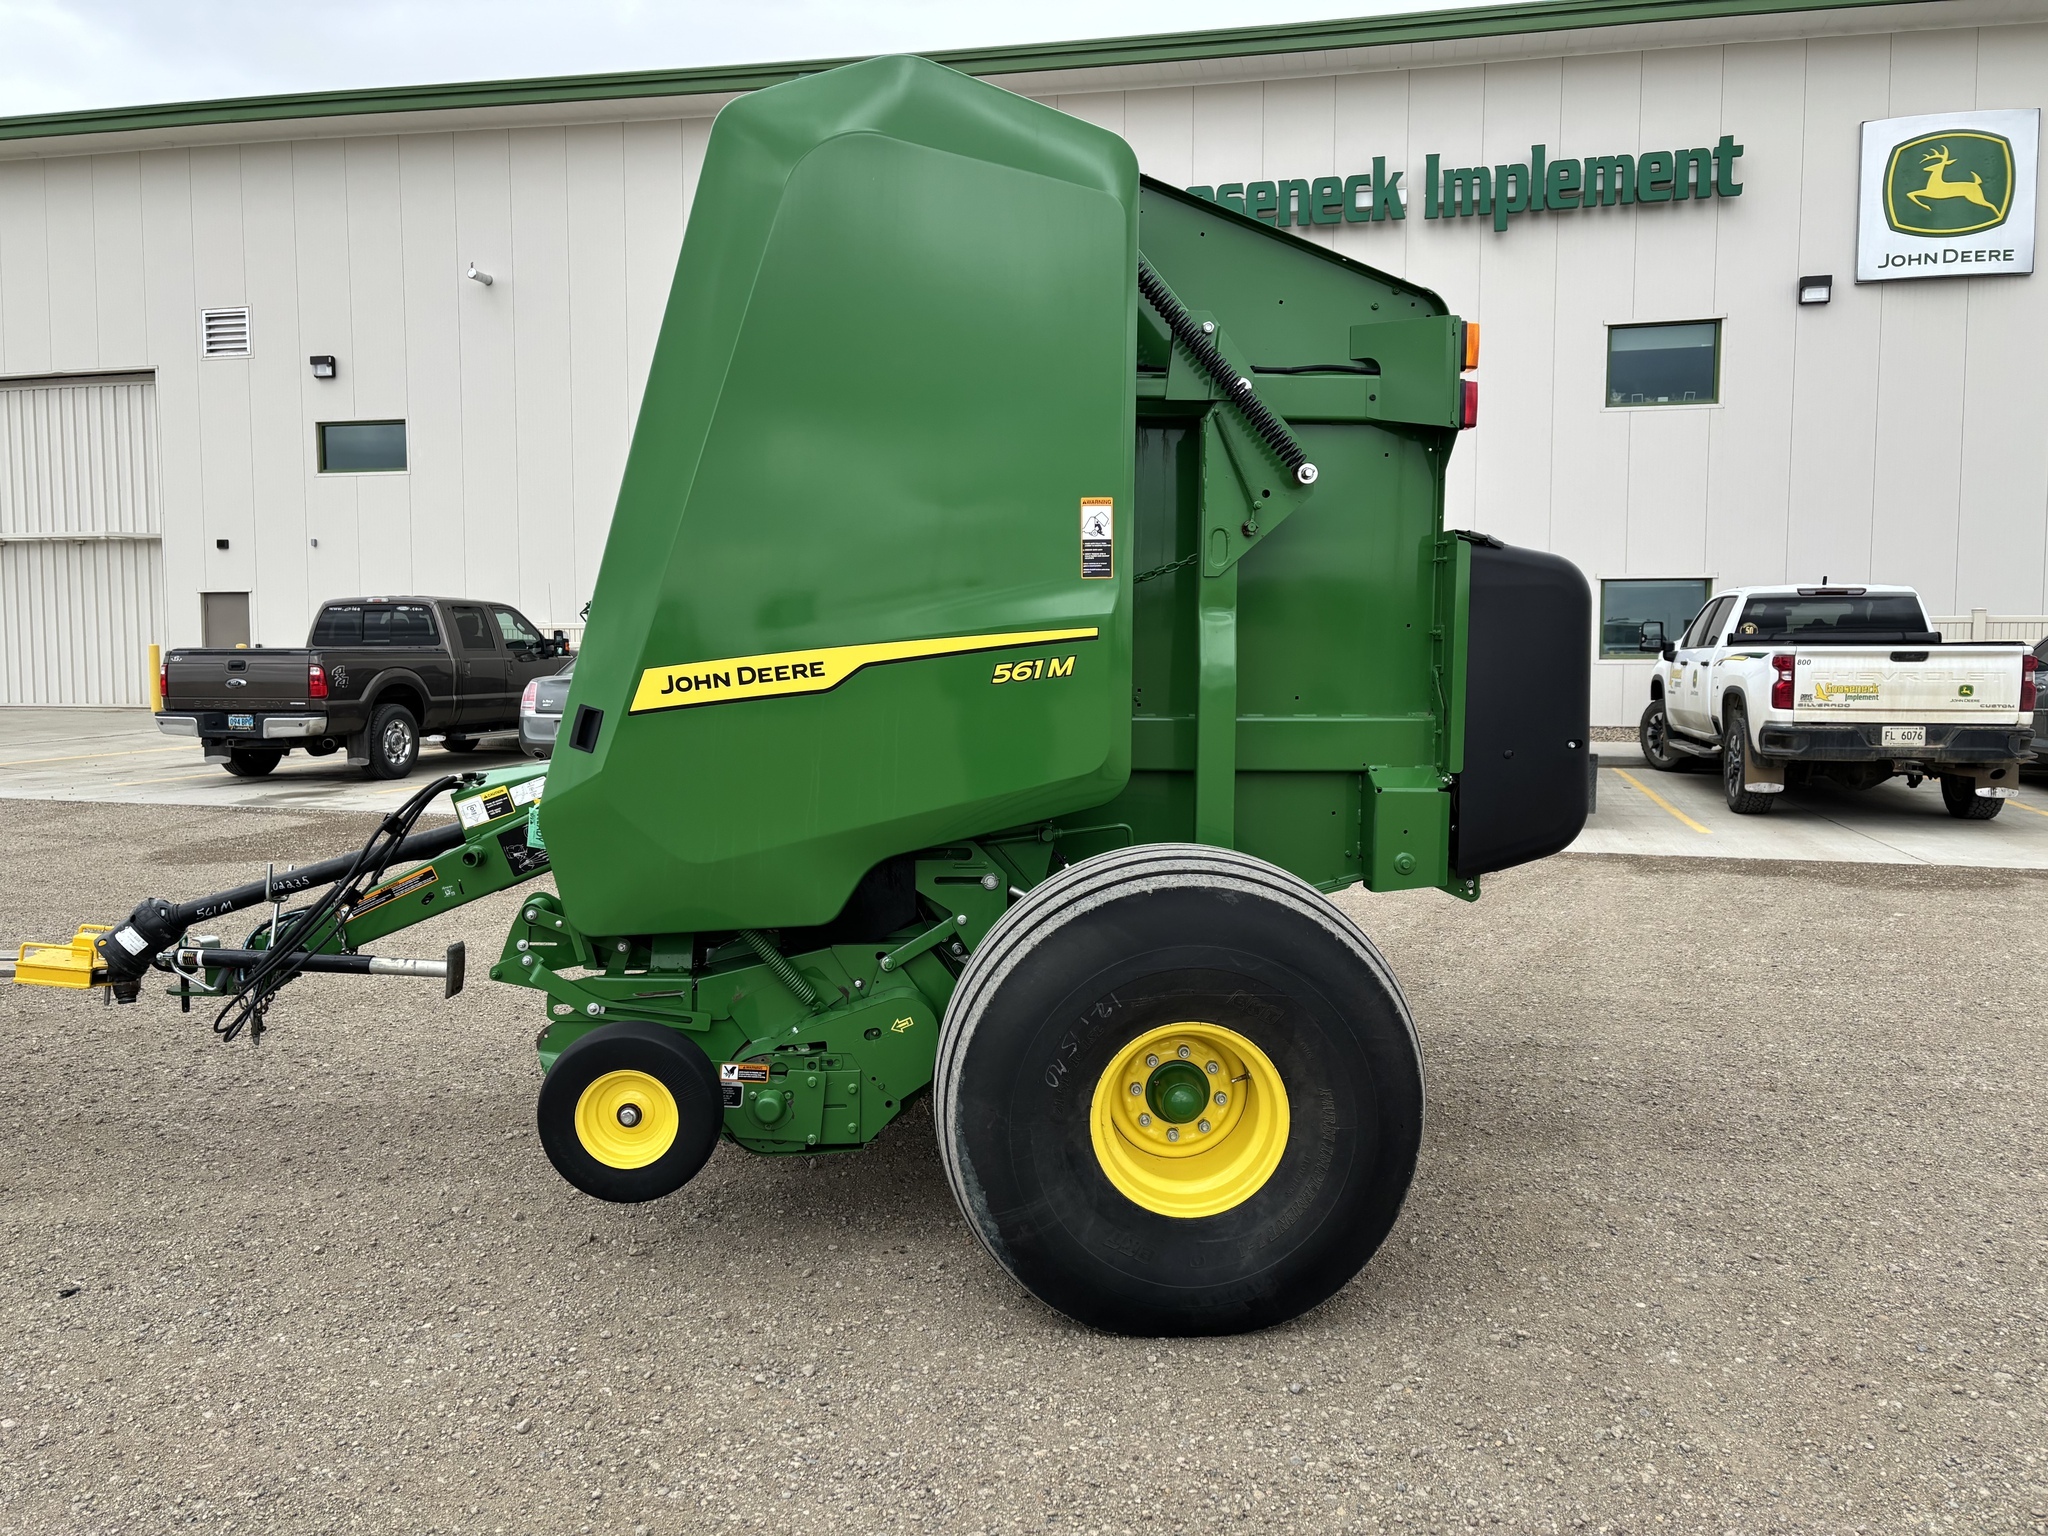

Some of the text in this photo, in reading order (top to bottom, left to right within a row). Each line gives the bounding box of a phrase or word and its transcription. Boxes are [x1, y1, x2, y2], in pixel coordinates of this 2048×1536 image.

[1424, 135, 1744, 232] Implement
[1877, 248, 2015, 269] JOHN DEERE
[990, 654, 1078, 685] 561 M
[1796, 658, 1812, 666] 800
[660, 661, 826, 695] JOHN DEERE
[1810, 671, 2007, 682] CHEVROLET
[1825, 682, 1880, 694] Gooseneck
[1844, 693, 1880, 702] Implement
[1884, 730, 1923, 741] FL 6076
[196, 900, 235, 918] 561 M
